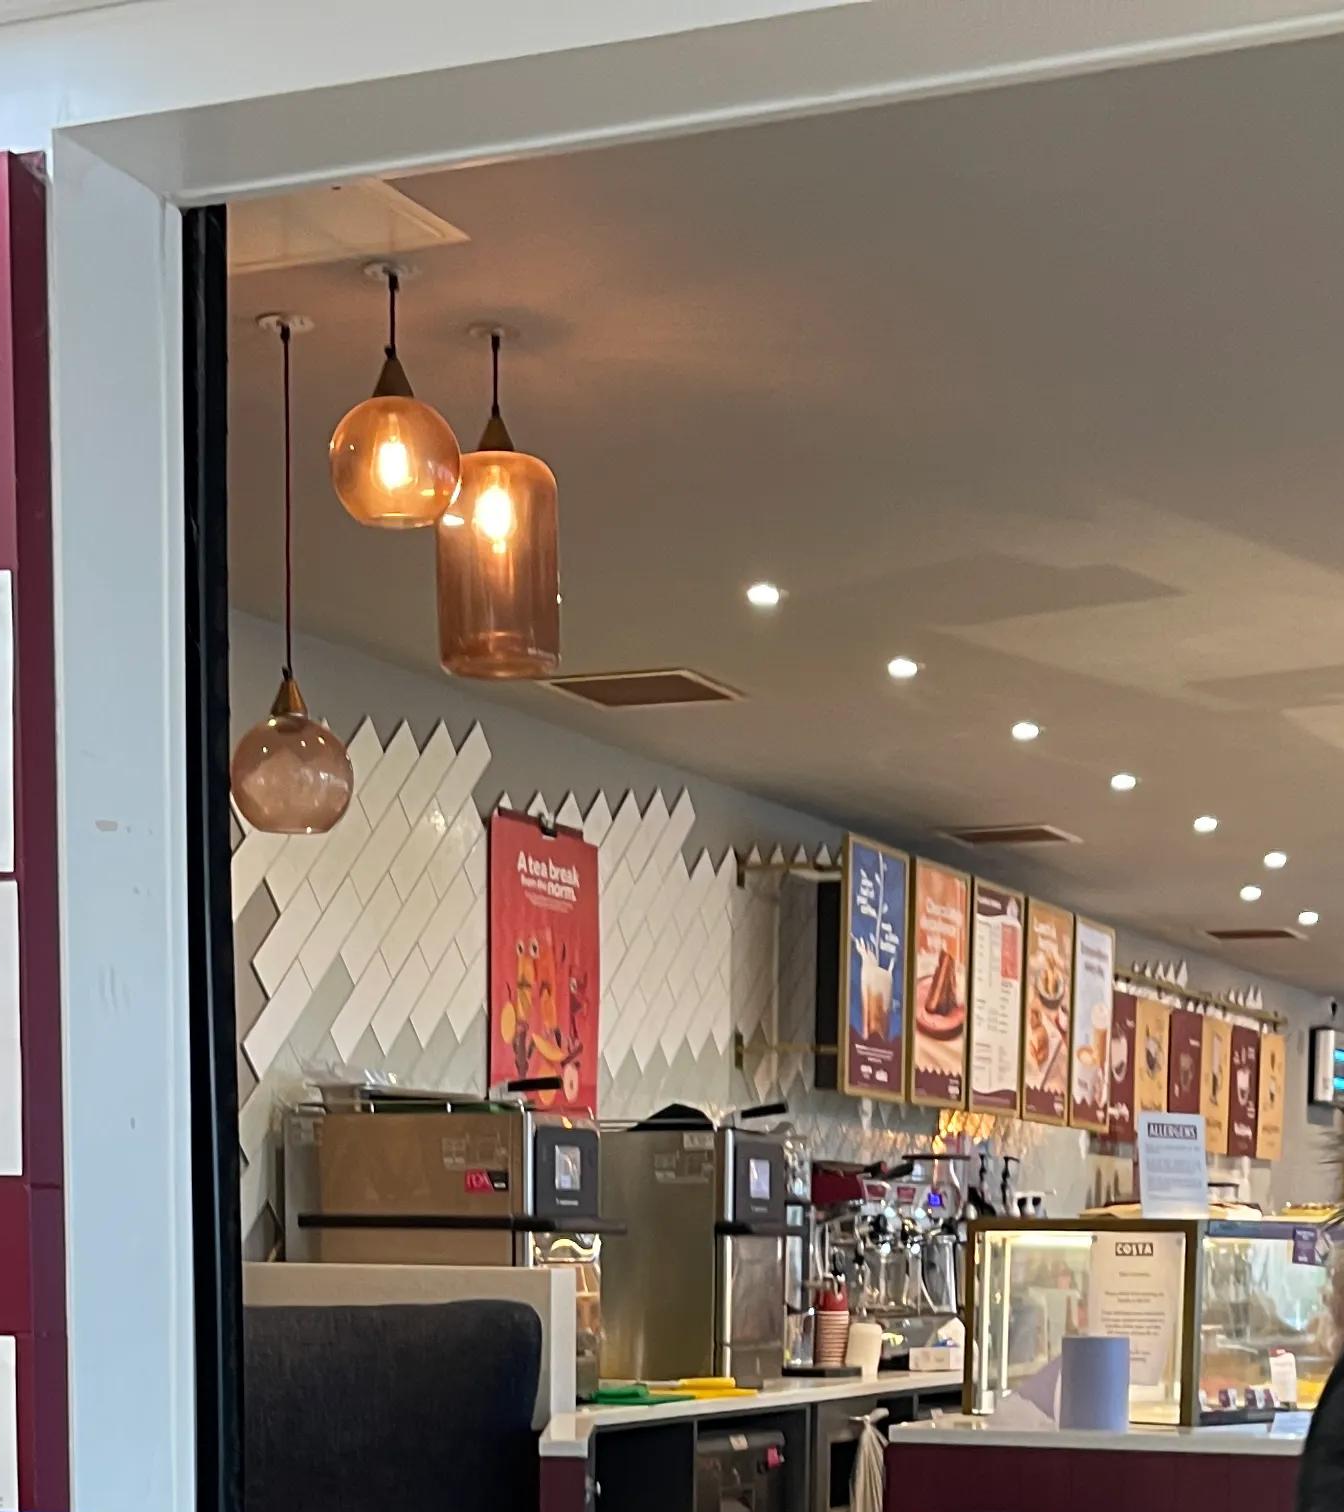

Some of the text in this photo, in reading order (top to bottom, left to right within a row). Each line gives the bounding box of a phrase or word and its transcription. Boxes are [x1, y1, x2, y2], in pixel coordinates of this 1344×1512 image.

[517, 850, 580, 888] A tea break
[1116, 1243, 1152, 1256] COSTA
